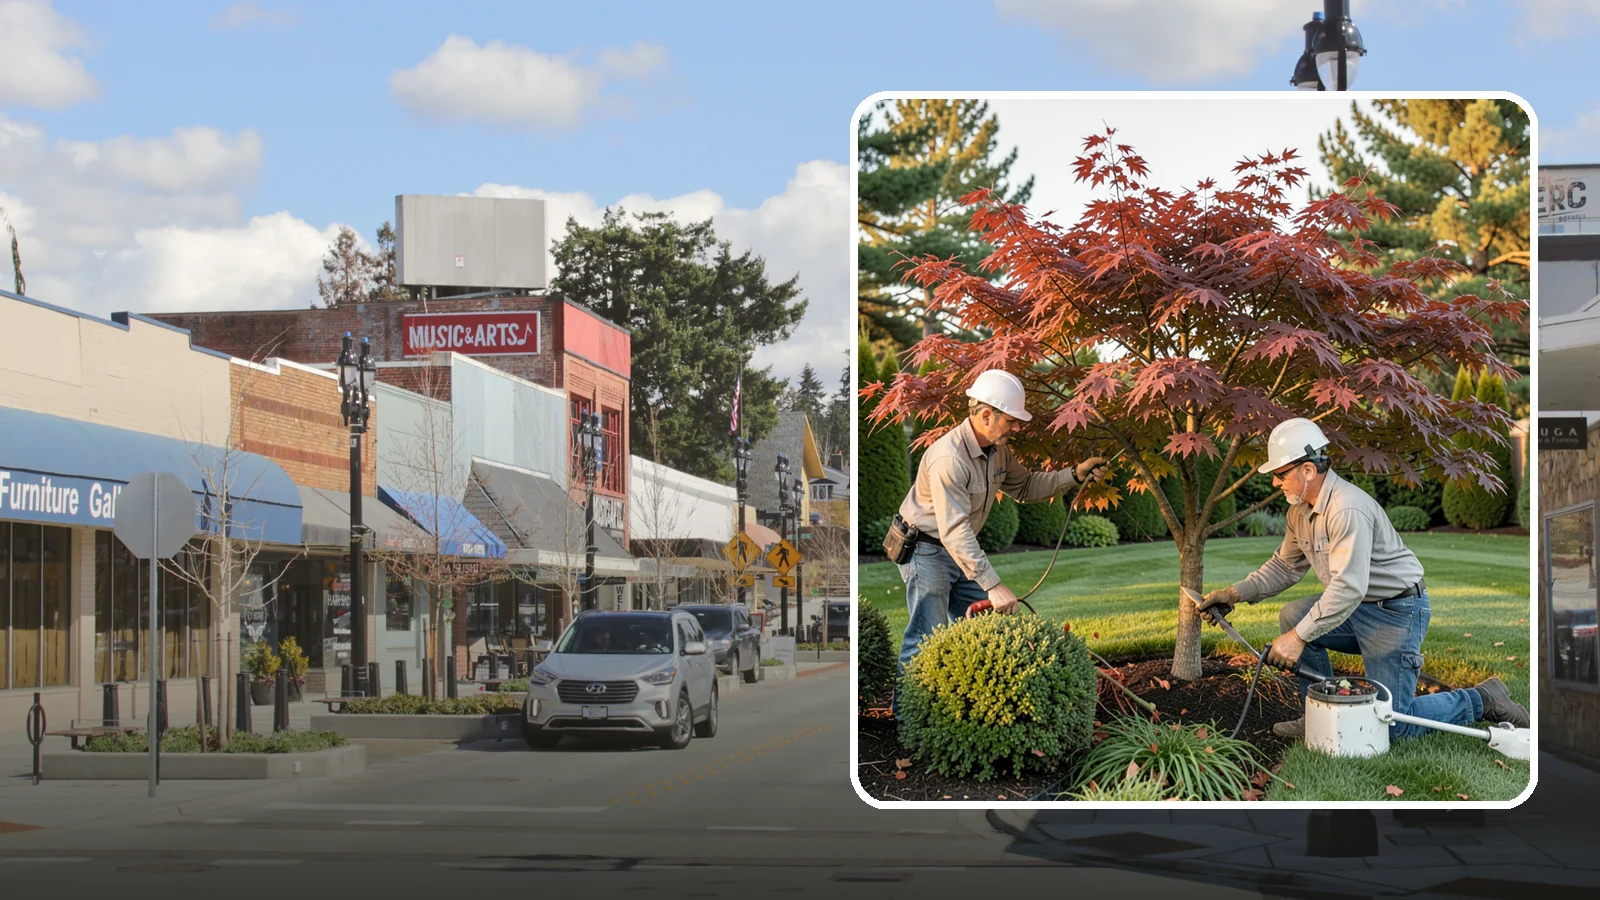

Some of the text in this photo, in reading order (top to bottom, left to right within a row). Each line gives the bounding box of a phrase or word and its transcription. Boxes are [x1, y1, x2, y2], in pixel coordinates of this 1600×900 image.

[408, 323, 519, 349] MUSIC&ARTS
[0, 471, 122, 519] Furniture Gal
[453, 563, 479, 574] SUSHI
